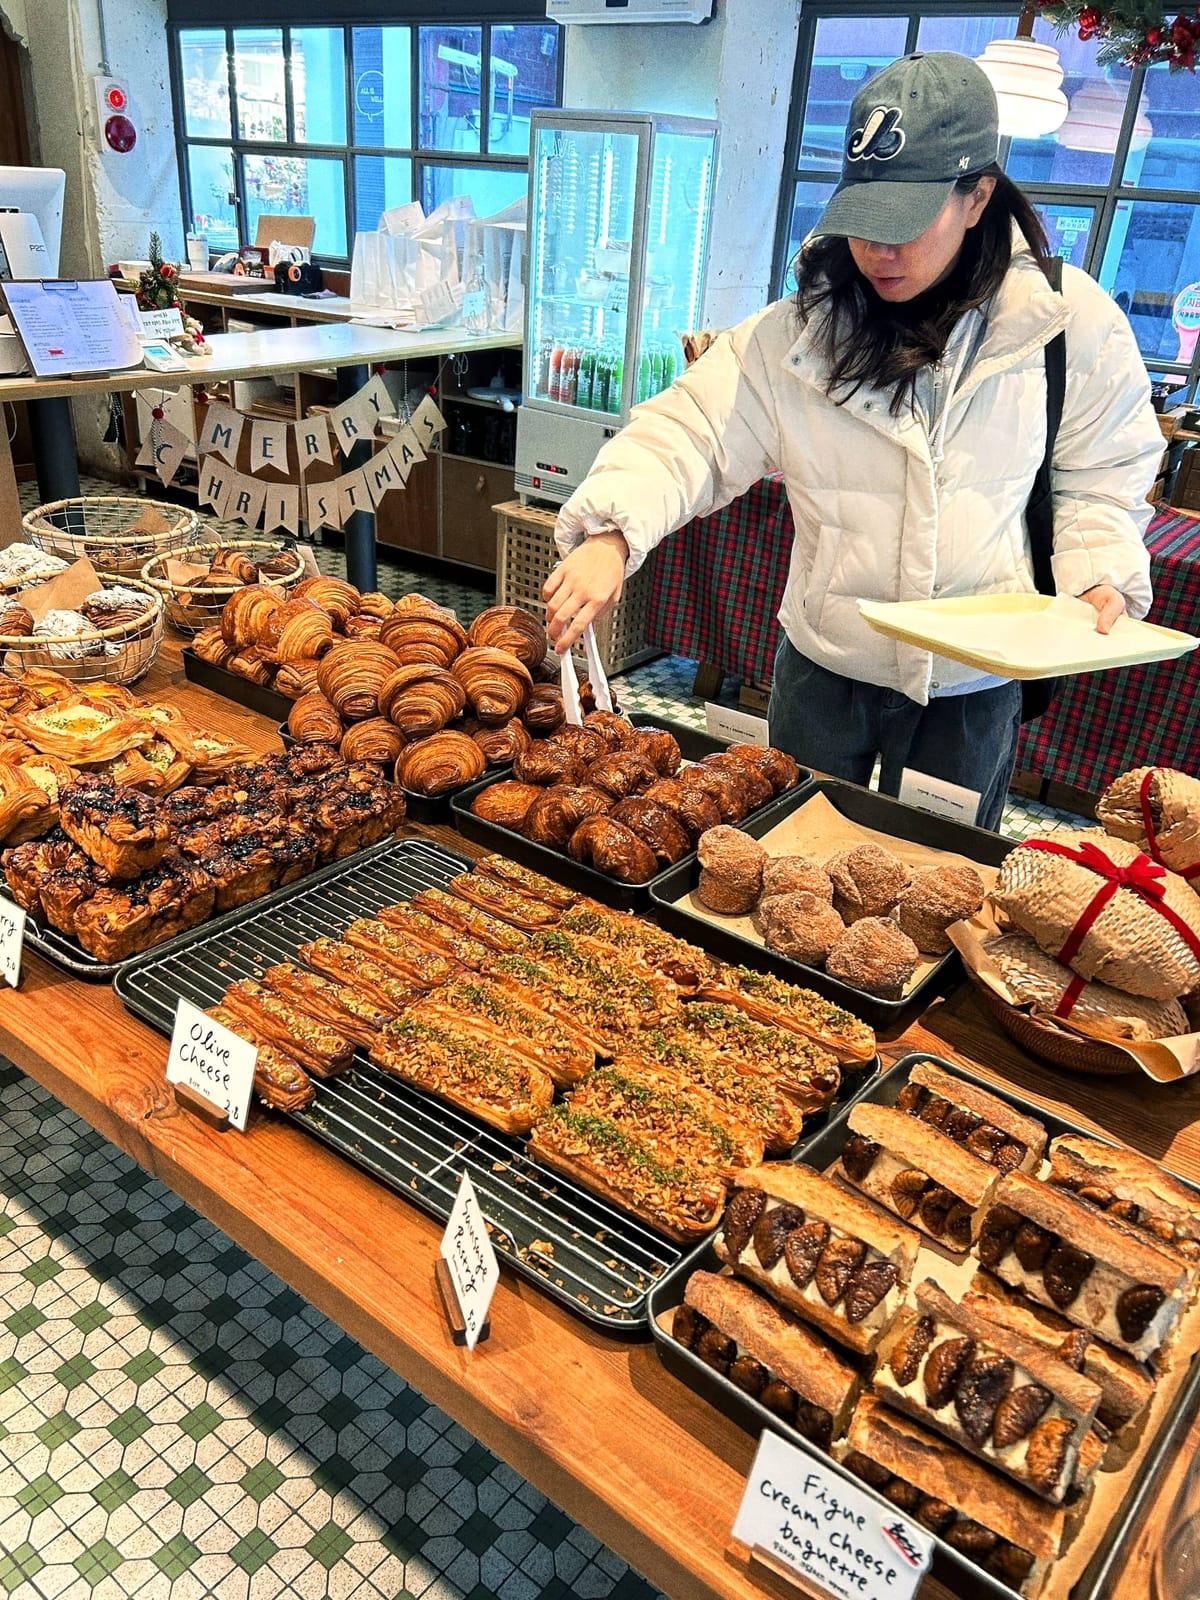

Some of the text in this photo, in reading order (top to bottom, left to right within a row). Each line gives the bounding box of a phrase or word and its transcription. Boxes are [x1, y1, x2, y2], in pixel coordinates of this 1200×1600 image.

[210, 391, 381, 459] MERRY
[155, 414, 435, 519] CHRISTMAS
[179, 1043, 230, 1091] Cheese
[190, 1023, 230, 1067] Olive
[454, 1225, 477, 1293] Pastry
[804, 1474, 866, 1531] Figue
[779, 1520, 868, 1592] baguette
